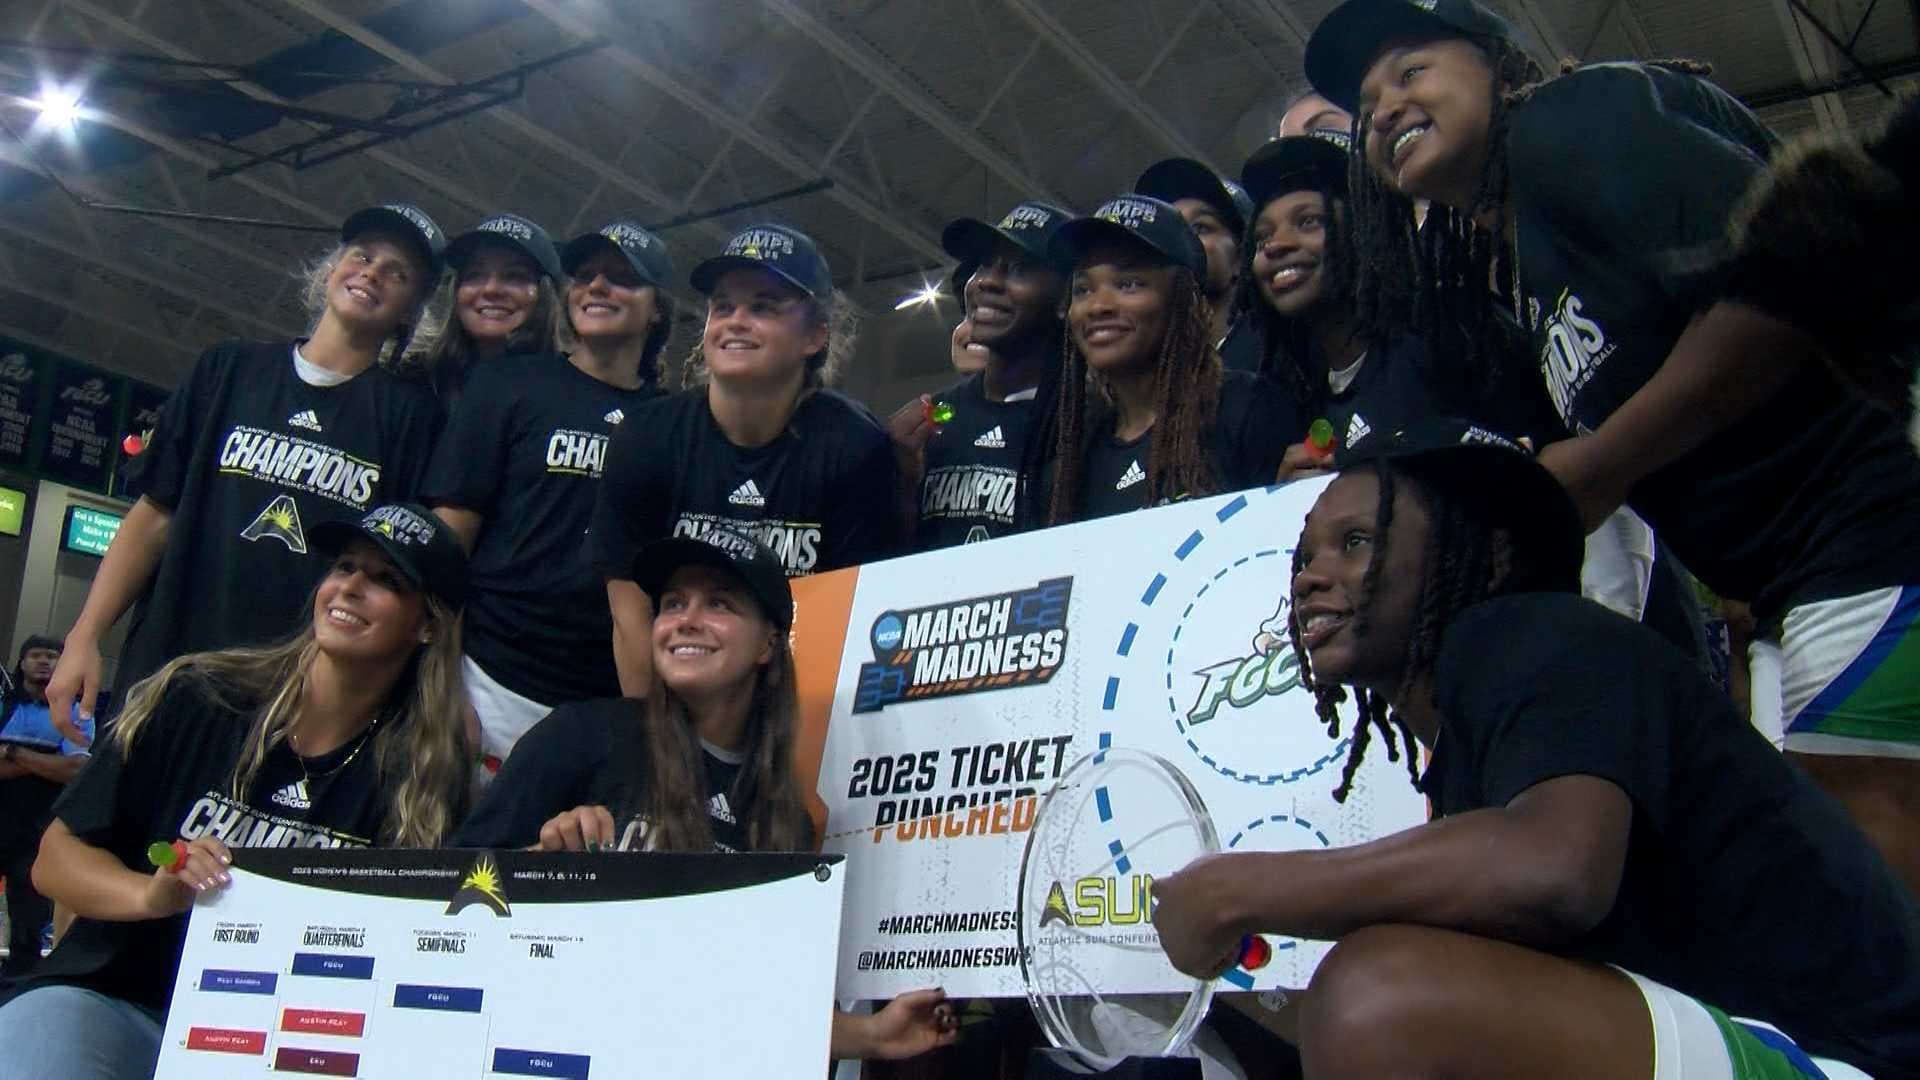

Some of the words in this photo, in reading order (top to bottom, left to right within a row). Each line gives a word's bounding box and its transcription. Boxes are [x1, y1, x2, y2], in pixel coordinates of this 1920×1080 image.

[219, 429, 380, 503] CHAMPIONS
[902, 598, 1012, 650] MARCH
[912, 629, 1065, 686] MADNESS
[848, 751, 940, 799] 2025
[950, 735, 1073, 788] TICKET
[271, 793, 312, 809] adidas
[873, 787, 1037, 844] PUNCHED
[303, 930, 365, 948] QUARTERFINALS
[416, 936, 466, 954] SEMIFINALS
[529, 943, 555, 959] FINAL
